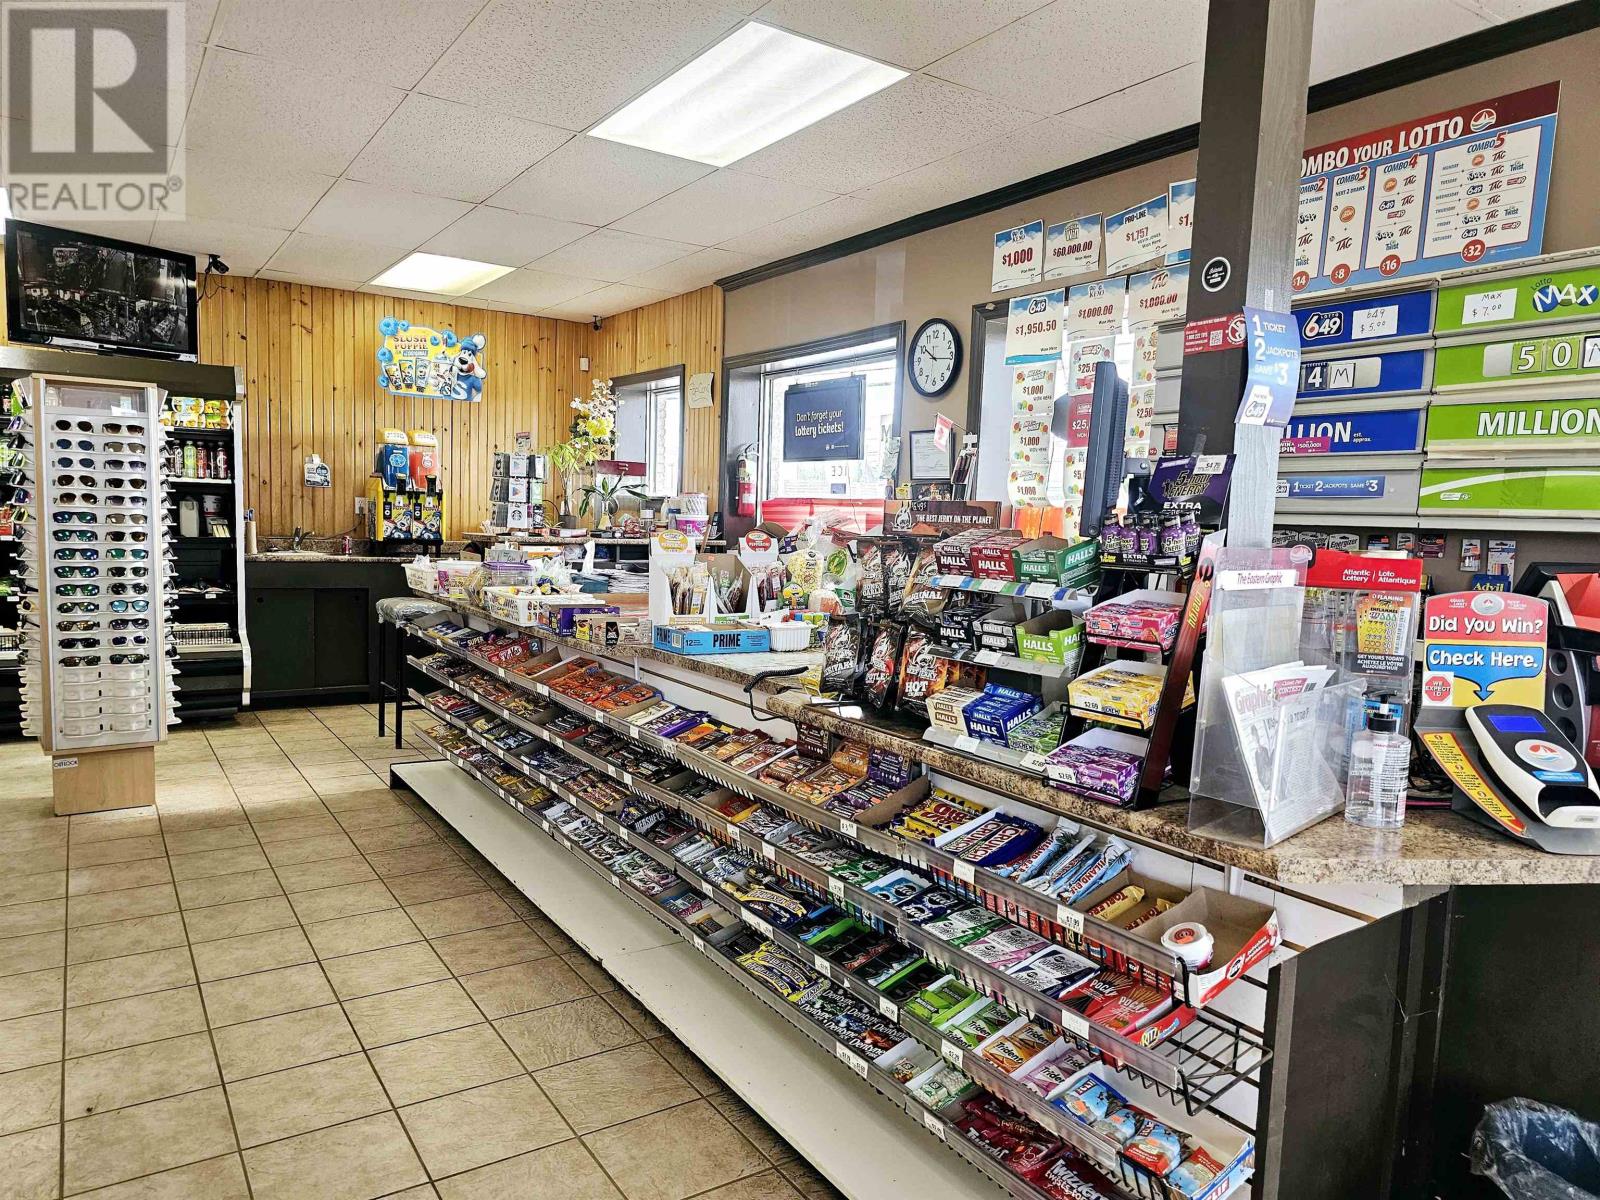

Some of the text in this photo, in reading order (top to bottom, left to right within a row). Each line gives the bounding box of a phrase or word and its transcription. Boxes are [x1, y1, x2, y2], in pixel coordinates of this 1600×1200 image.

[1353, 141, 1393, 164] YOUR
[1398, 117, 1464, 152] LOTTO
[1124, 209, 1147, 224] PRO-LINE
[1052, 240, 1093, 257] $60,000.00
[1464, 245, 1481, 256] $32
[1002, 247, 1033, 268] $1,000
[1382, 260, 1397, 271] $16
[1335, 269, 1344, 278] $8
[1531, 277, 1553, 291] Lotto
[1533, 283, 1599, 313] MAX
[1077, 304, 1114, 319] $1,000.00
[1015, 319, 1057, 337] $1,950.50
[1252, 315, 1286, 337] 1 TICKET
[1304, 314, 1342, 340] 649
[1254, 339, 1299, 361] 2 JACKPOTS
[796, 408, 843, 423] Don't forget your
[795, 422, 844, 439] lottery tickets!
[1293, 481, 1300, 492] 1
[1315, 480, 1324, 492] 2
[1163, 502, 1202, 510] EXTRA
[926, 514, 972, 524] BEST JERKY ON THE
[1272, 534, 1297, 544] Energizer
[1331, 539, 1358, 549] Energizer
[982, 548, 1001, 556] HALLS
[1068, 547, 1094, 564] HALLS
[941, 555, 967, 567] HALLS
[978, 559, 1008, 571] HALLS
[1023, 564, 1047, 572] HALLS
[1343, 569, 1370, 577] Atlantic
[1343, 575, 1416, 585] Lottery Atlantique
[1473, 581, 1504, 592] Advil
[1429, 615, 1544, 634] Did You Win?
[712, 633, 742, 648] PRIME
[940, 627, 966, 639] HALLS
[467, 636, 484, 646] SUPER
[531, 642, 539, 651] 2
[983, 636, 1006, 647] HALLS
[1023, 639, 1055, 652] HALLS
[1429, 650, 1539, 668] Check Here.
[905, 681, 928, 692] HOT
[998, 688, 1021, 698] HALLS
[1084, 701, 1099, 709] $2.69
[936, 714, 957, 723] HALLS
[1007, 709, 1033, 729] HALLS
[970, 722, 999, 736] HALLS
[1058, 772, 1072, 781] $2.69
[966, 825, 1021, 862] CRUNCH
[1090, 978, 1118, 997] POCKY
[823, 989, 856, 1006] Dentyne
[1119, 996, 1149, 1012] POCKY
[802, 1003, 834, 1021] Dentyne
[849, 1008, 881, 1024] Dentyne
[825, 1022, 857, 1040] Dentyne
[873, 1023, 909, 1039] Dentyne
[1142, 1028, 1159, 1046] RITZ
[849, 1038, 887, 1055] Dentyne
[995, 1041, 1025, 1063] Trident
